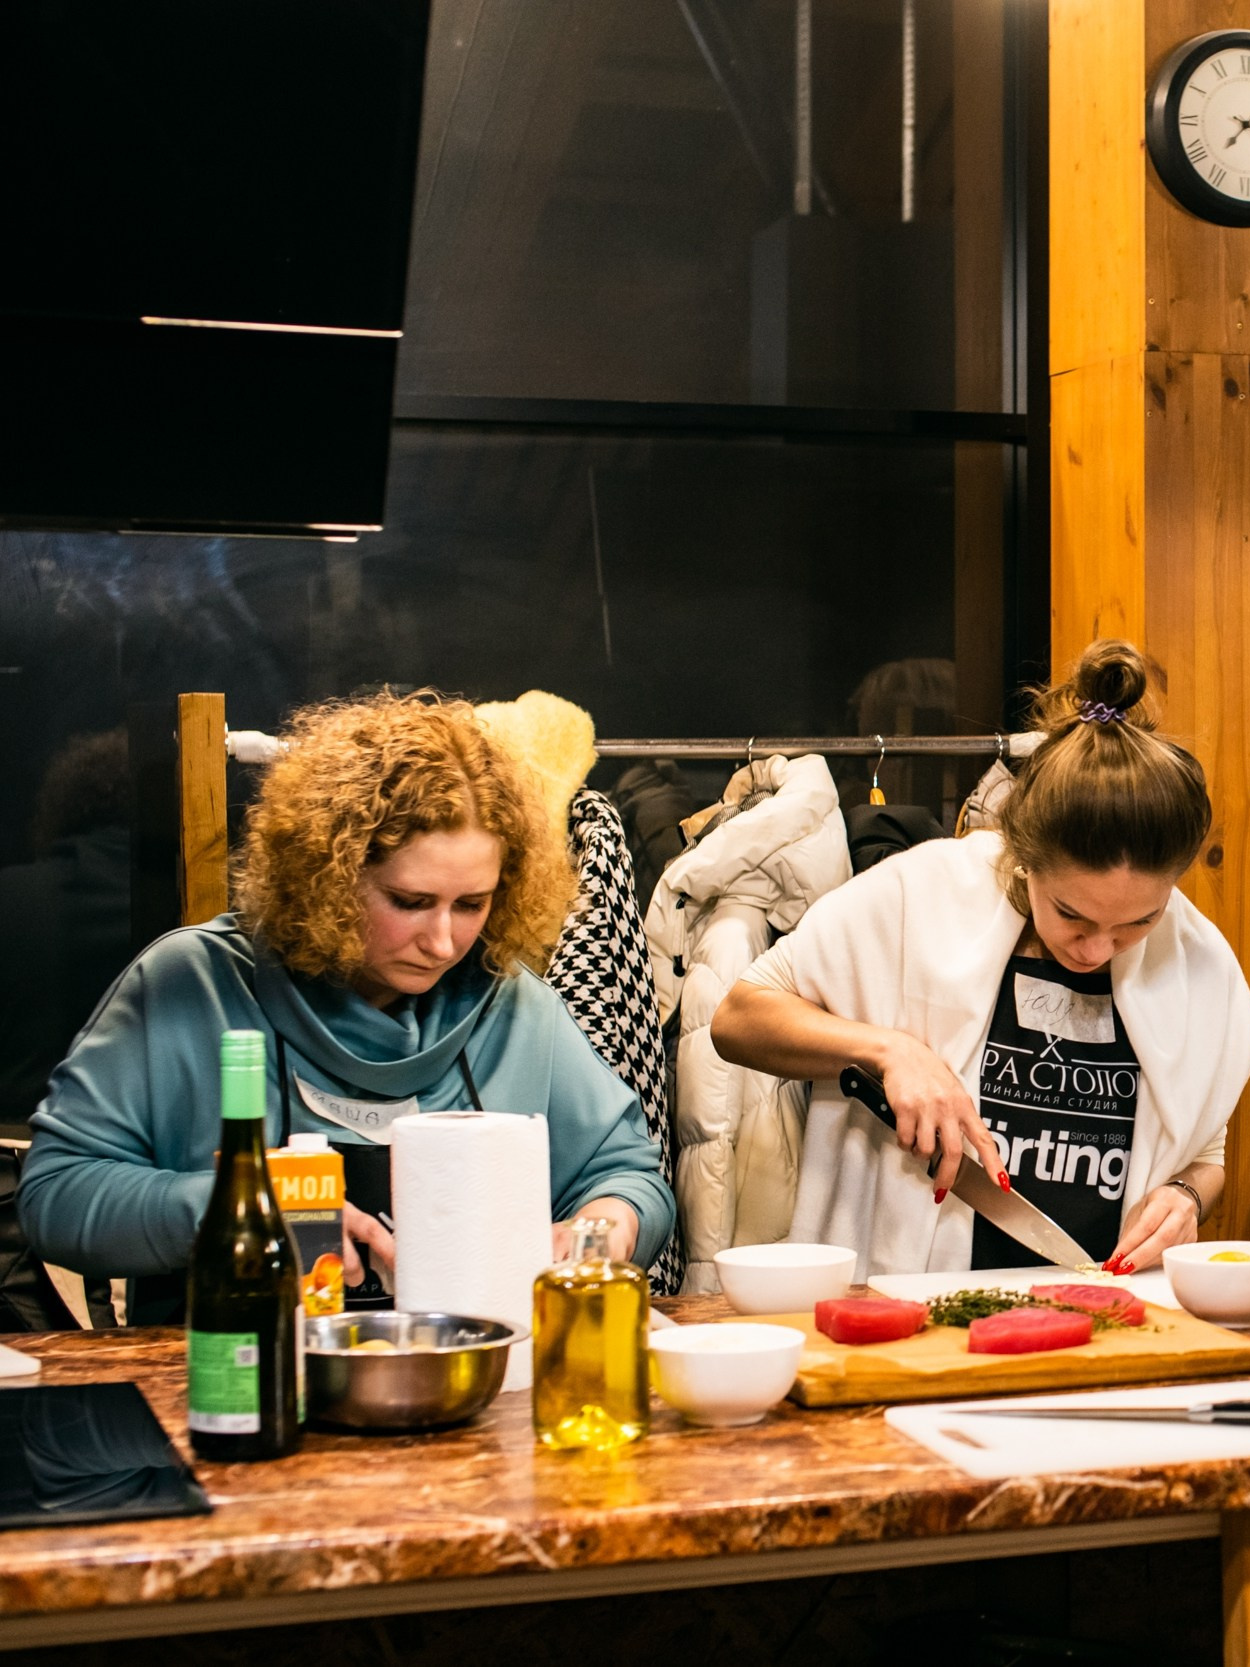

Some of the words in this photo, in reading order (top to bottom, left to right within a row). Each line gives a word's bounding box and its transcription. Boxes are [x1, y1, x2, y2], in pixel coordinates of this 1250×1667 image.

[981, 1049, 1019, 1085] РА
[1029, 1061, 1140, 1098] СТОЛО
[982, 1082, 1061, 1105] ЛИНАРНАЯ
[1067, 1097, 1118, 1111] СТУДИЯ
[1070, 1131, 1100, 1143] since
[1103, 1133, 1127, 1146] 1889
[981, 1117, 1133, 1200] örting
